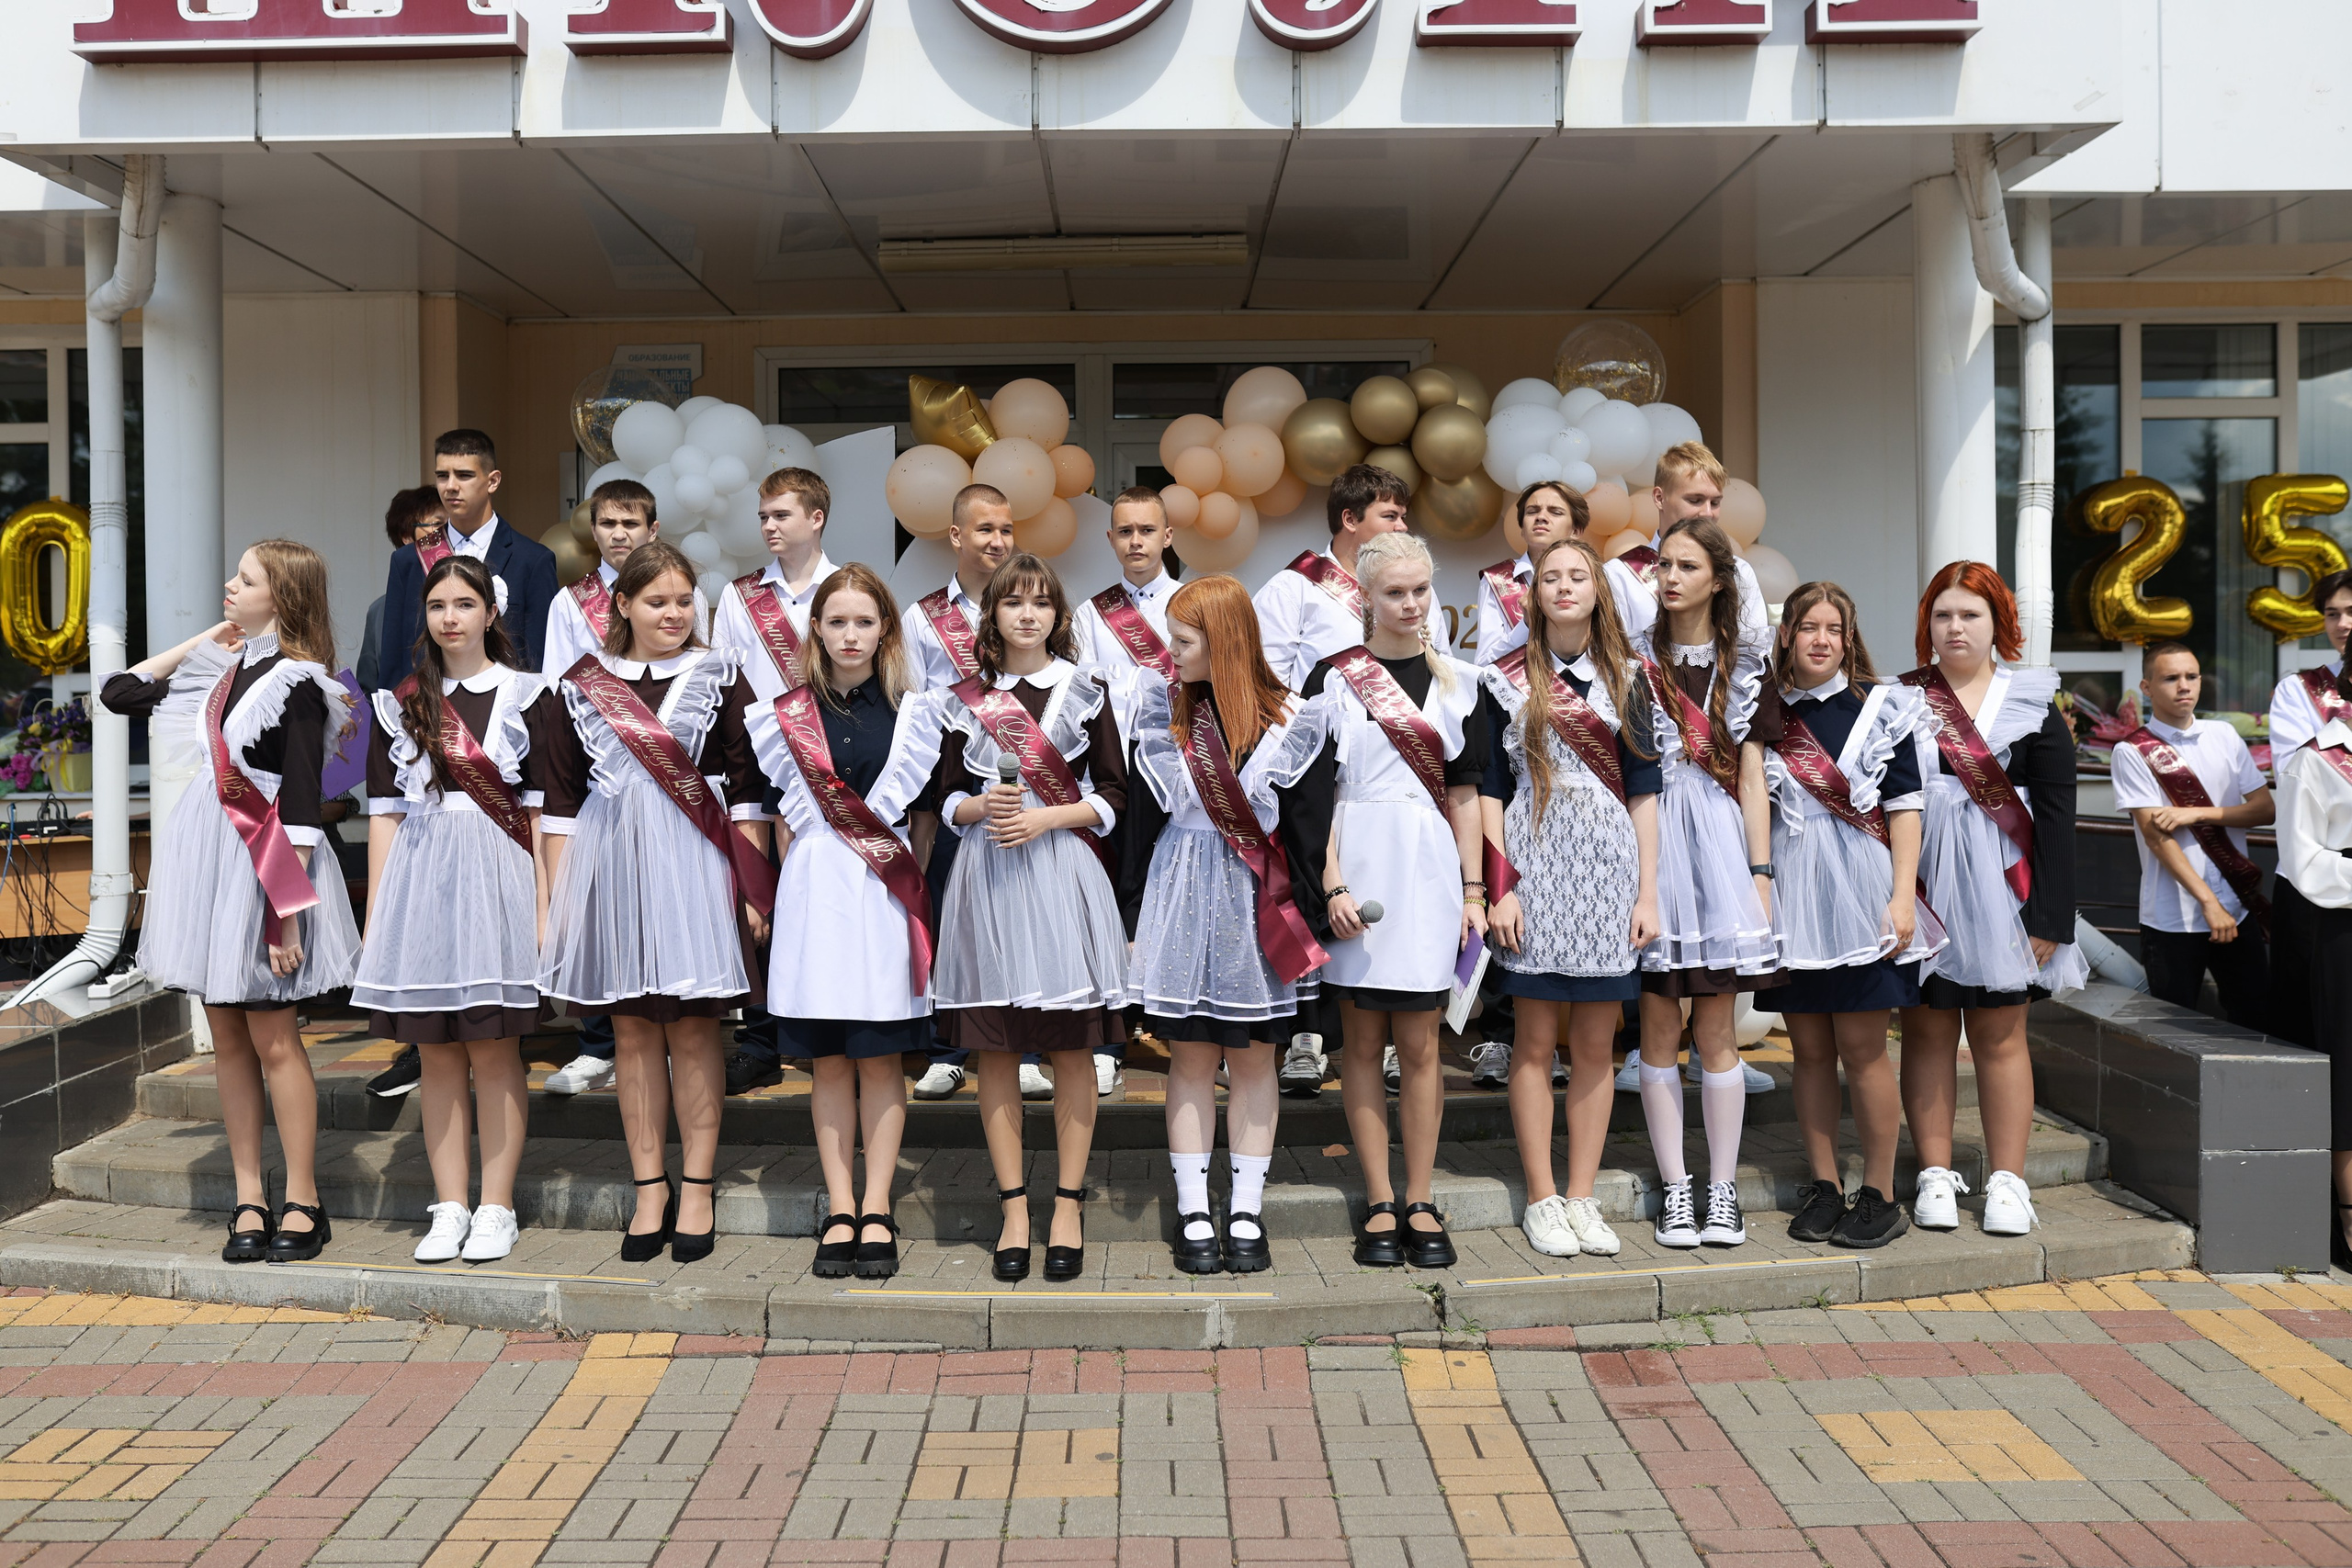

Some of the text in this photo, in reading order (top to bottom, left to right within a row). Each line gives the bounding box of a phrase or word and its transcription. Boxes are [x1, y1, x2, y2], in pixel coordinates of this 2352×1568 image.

[628, 354, 691, 362] ОБРАЗОВАНИЕ
[591, 680, 708, 807] Выпускница 2025
[218, 768, 250, 799] 2025
[1977, 783, 2010, 811] 2025
[858, 831, 902, 863] 2025
